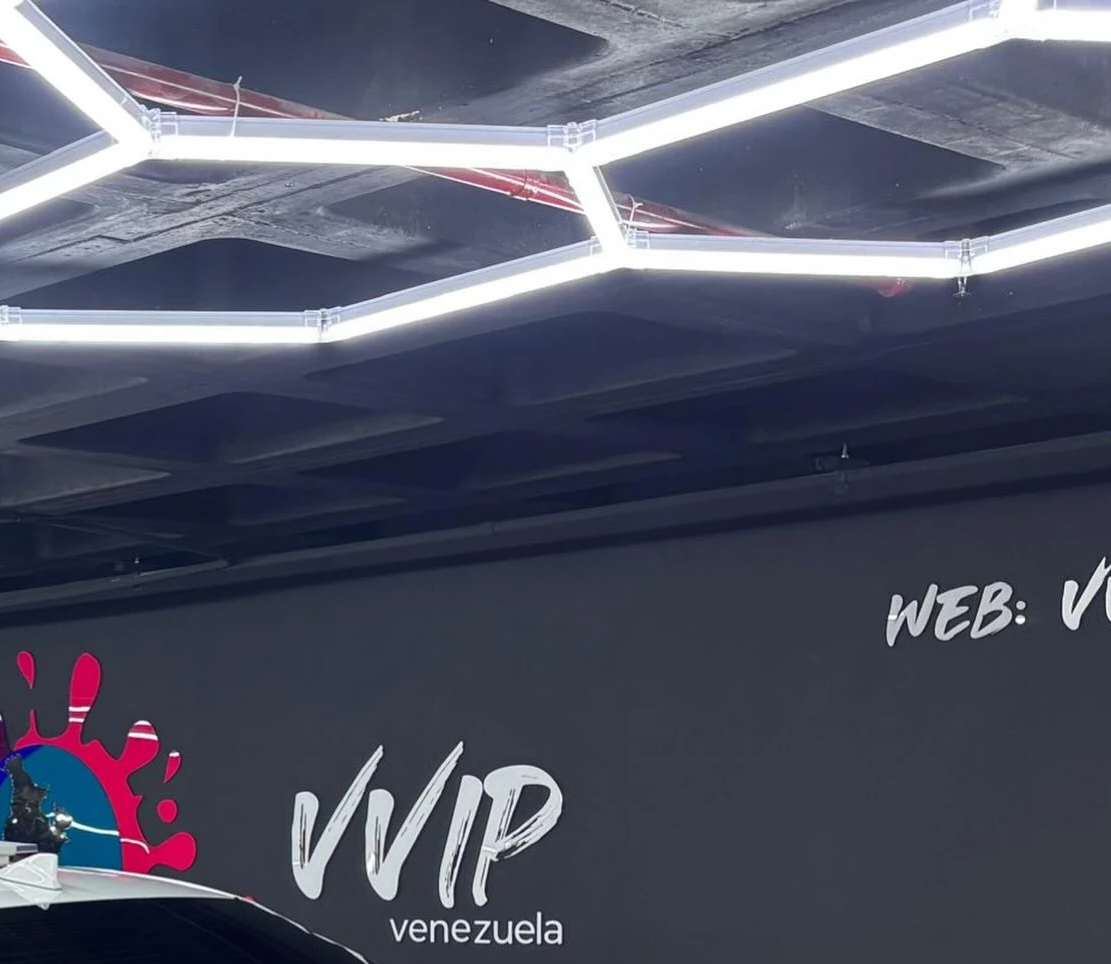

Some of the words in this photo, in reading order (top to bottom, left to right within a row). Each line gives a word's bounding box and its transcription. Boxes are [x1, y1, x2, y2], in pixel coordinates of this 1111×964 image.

[886, 581, 1026, 647] WEB:
[1061, 556, 1111, 631] V
[291, 741, 563, 908] VVIP
[389, 911, 563, 945] venezuela
